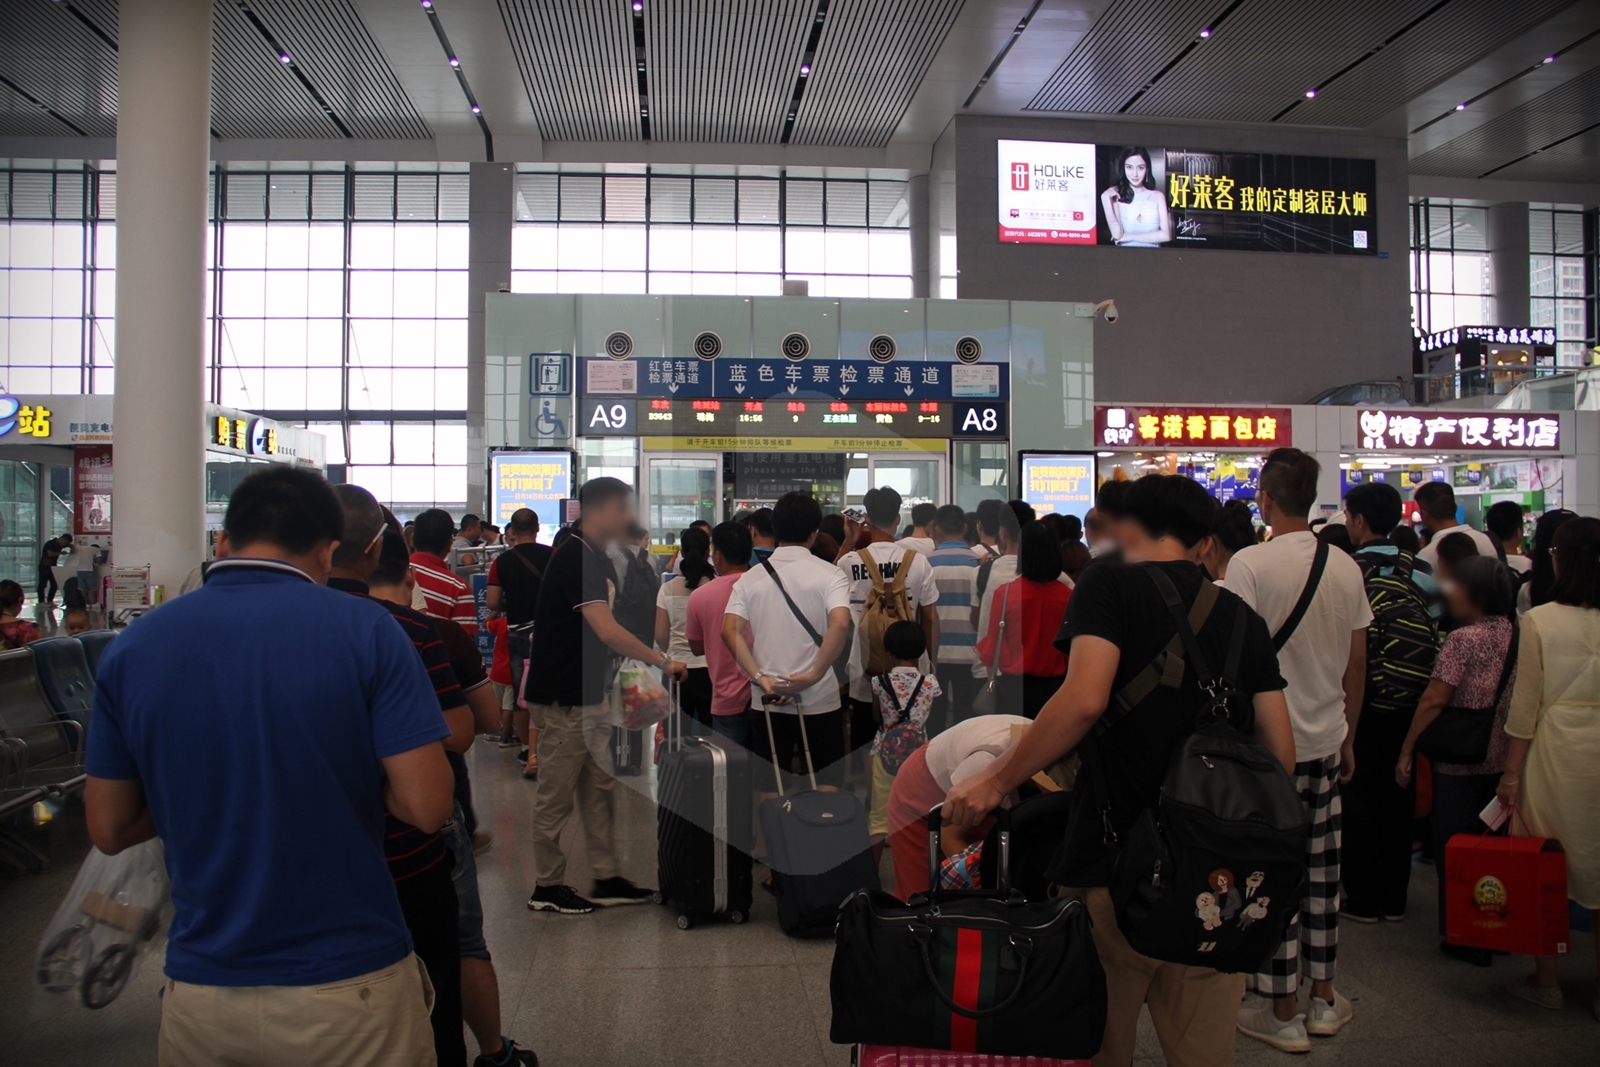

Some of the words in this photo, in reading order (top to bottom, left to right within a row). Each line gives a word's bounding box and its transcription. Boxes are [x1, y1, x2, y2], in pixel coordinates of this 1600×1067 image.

[1034, 178, 1068, 192] 好莱客
[1170, 173, 1234, 210] 好莱客
[1240, 186, 1368, 216] 我的定制家居大师
[648, 360, 700, 372] 红色车票
[648, 372, 700, 384] 检票通道
[728, 364, 940, 384] 蓝色车票检票通道
[652, 400, 670, 410] 车次
[692, 400, 722, 411] 终到站
[744, 402, 764, 412] 开点
[786, 402, 806, 412] 站台
[589, 404, 628, 428] A9
[792, 414, 799, 423] 9
[962, 408, 998, 432] A8
[68, 422, 113, 433] 便民充电
[1138, 414, 1277, 440] 客诺香面包店
[1388, 416, 1559, 447] 特产便利店
[742, 452, 836, 464] 请使用垂直电梯
[744, 466, 776, 474] please
